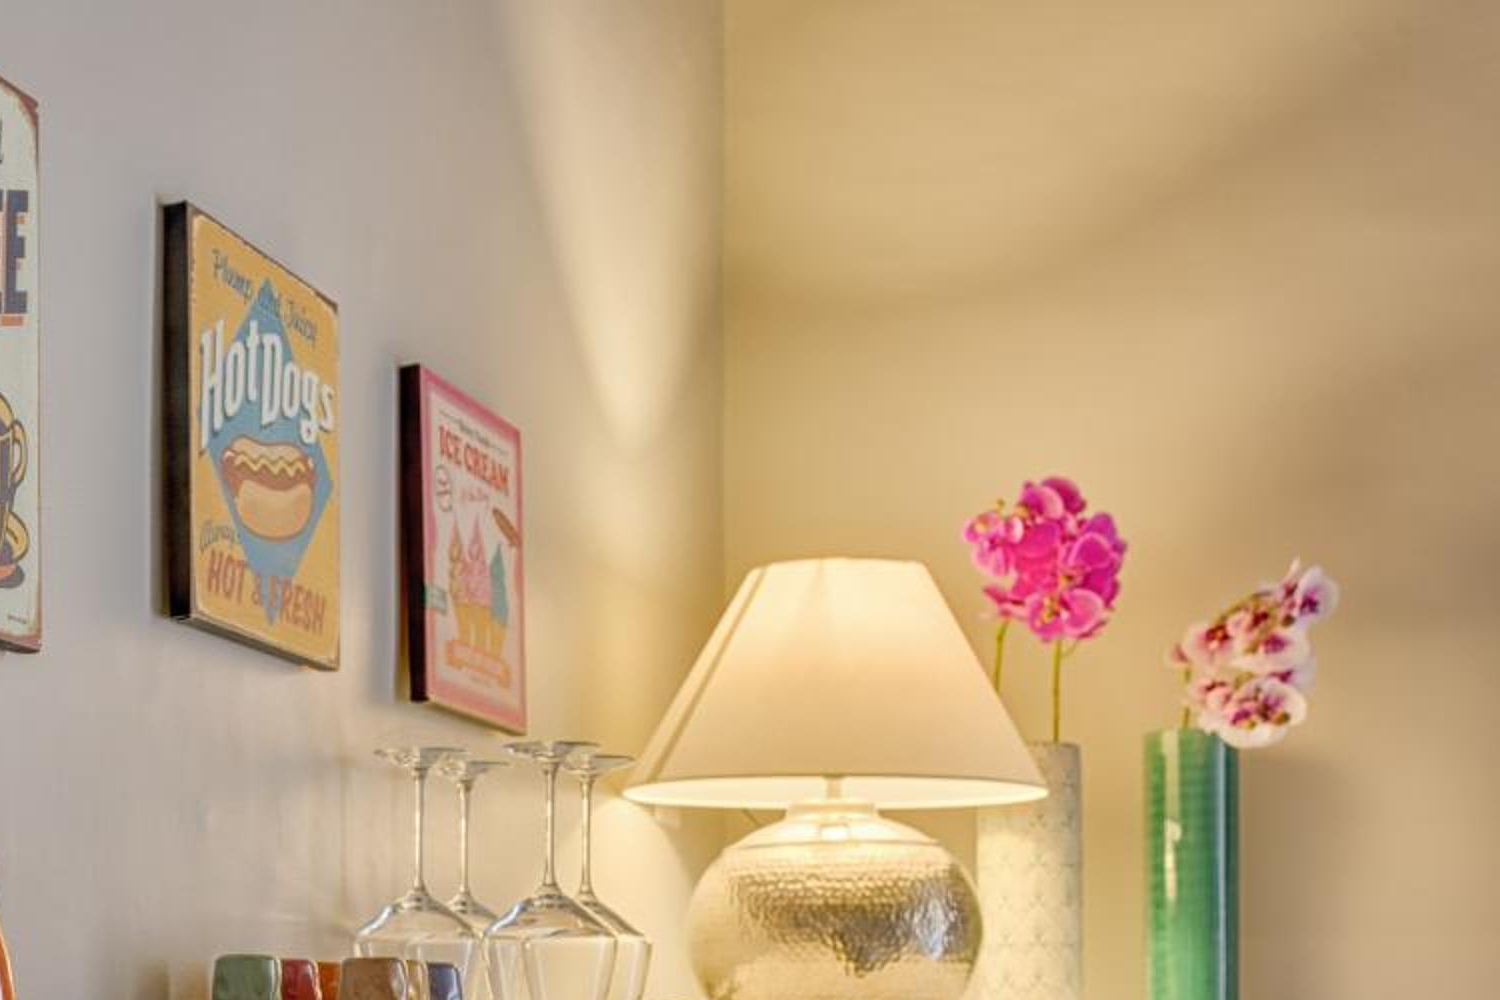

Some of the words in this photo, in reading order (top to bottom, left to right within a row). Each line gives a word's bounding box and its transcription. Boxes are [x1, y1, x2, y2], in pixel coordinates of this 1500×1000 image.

[439, 422, 462, 467] ICE
[463, 441, 509, 497] CREAM
[206, 547, 244, 606] HOT
[267, 574, 326, 635] FRESH
